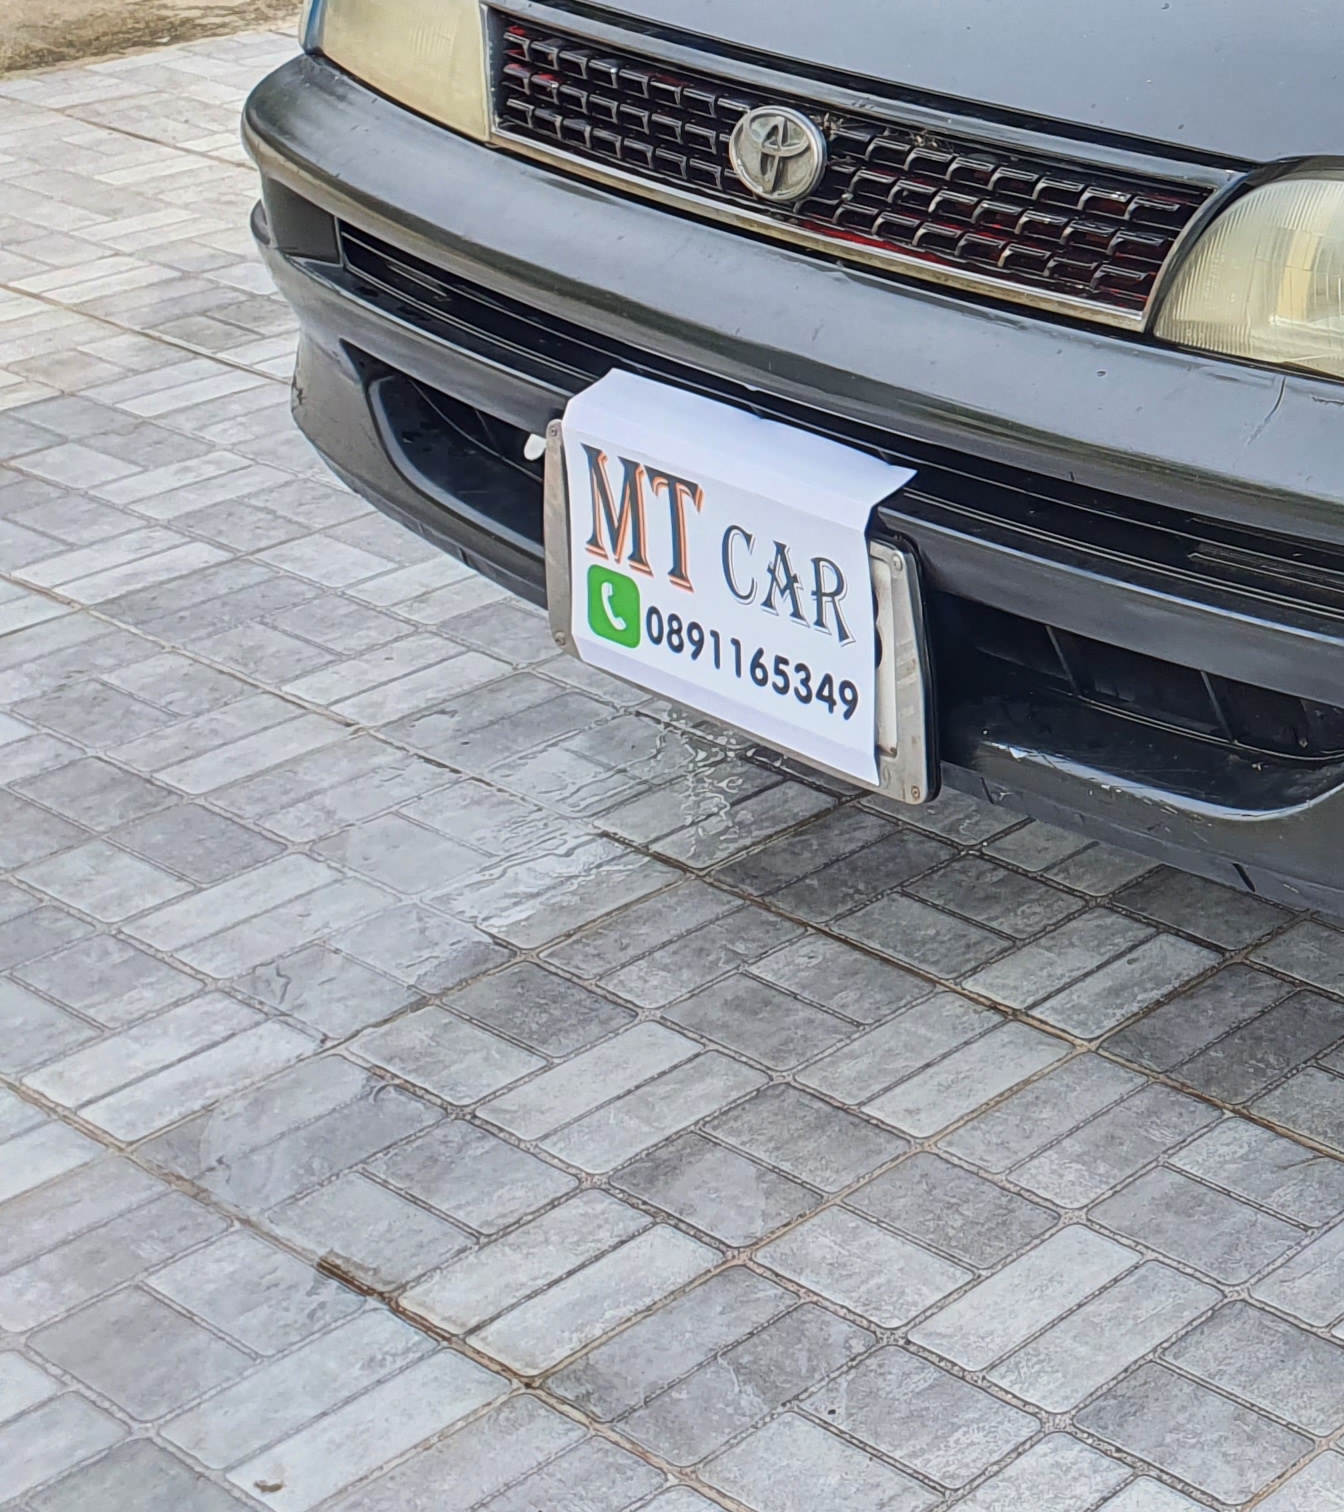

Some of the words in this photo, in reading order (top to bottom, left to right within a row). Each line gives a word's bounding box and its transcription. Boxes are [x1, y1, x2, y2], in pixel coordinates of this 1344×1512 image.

[580, 443, 704, 593] MT
[721, 524, 856, 647] CAR
[645, 605, 859, 721] 0891165349
